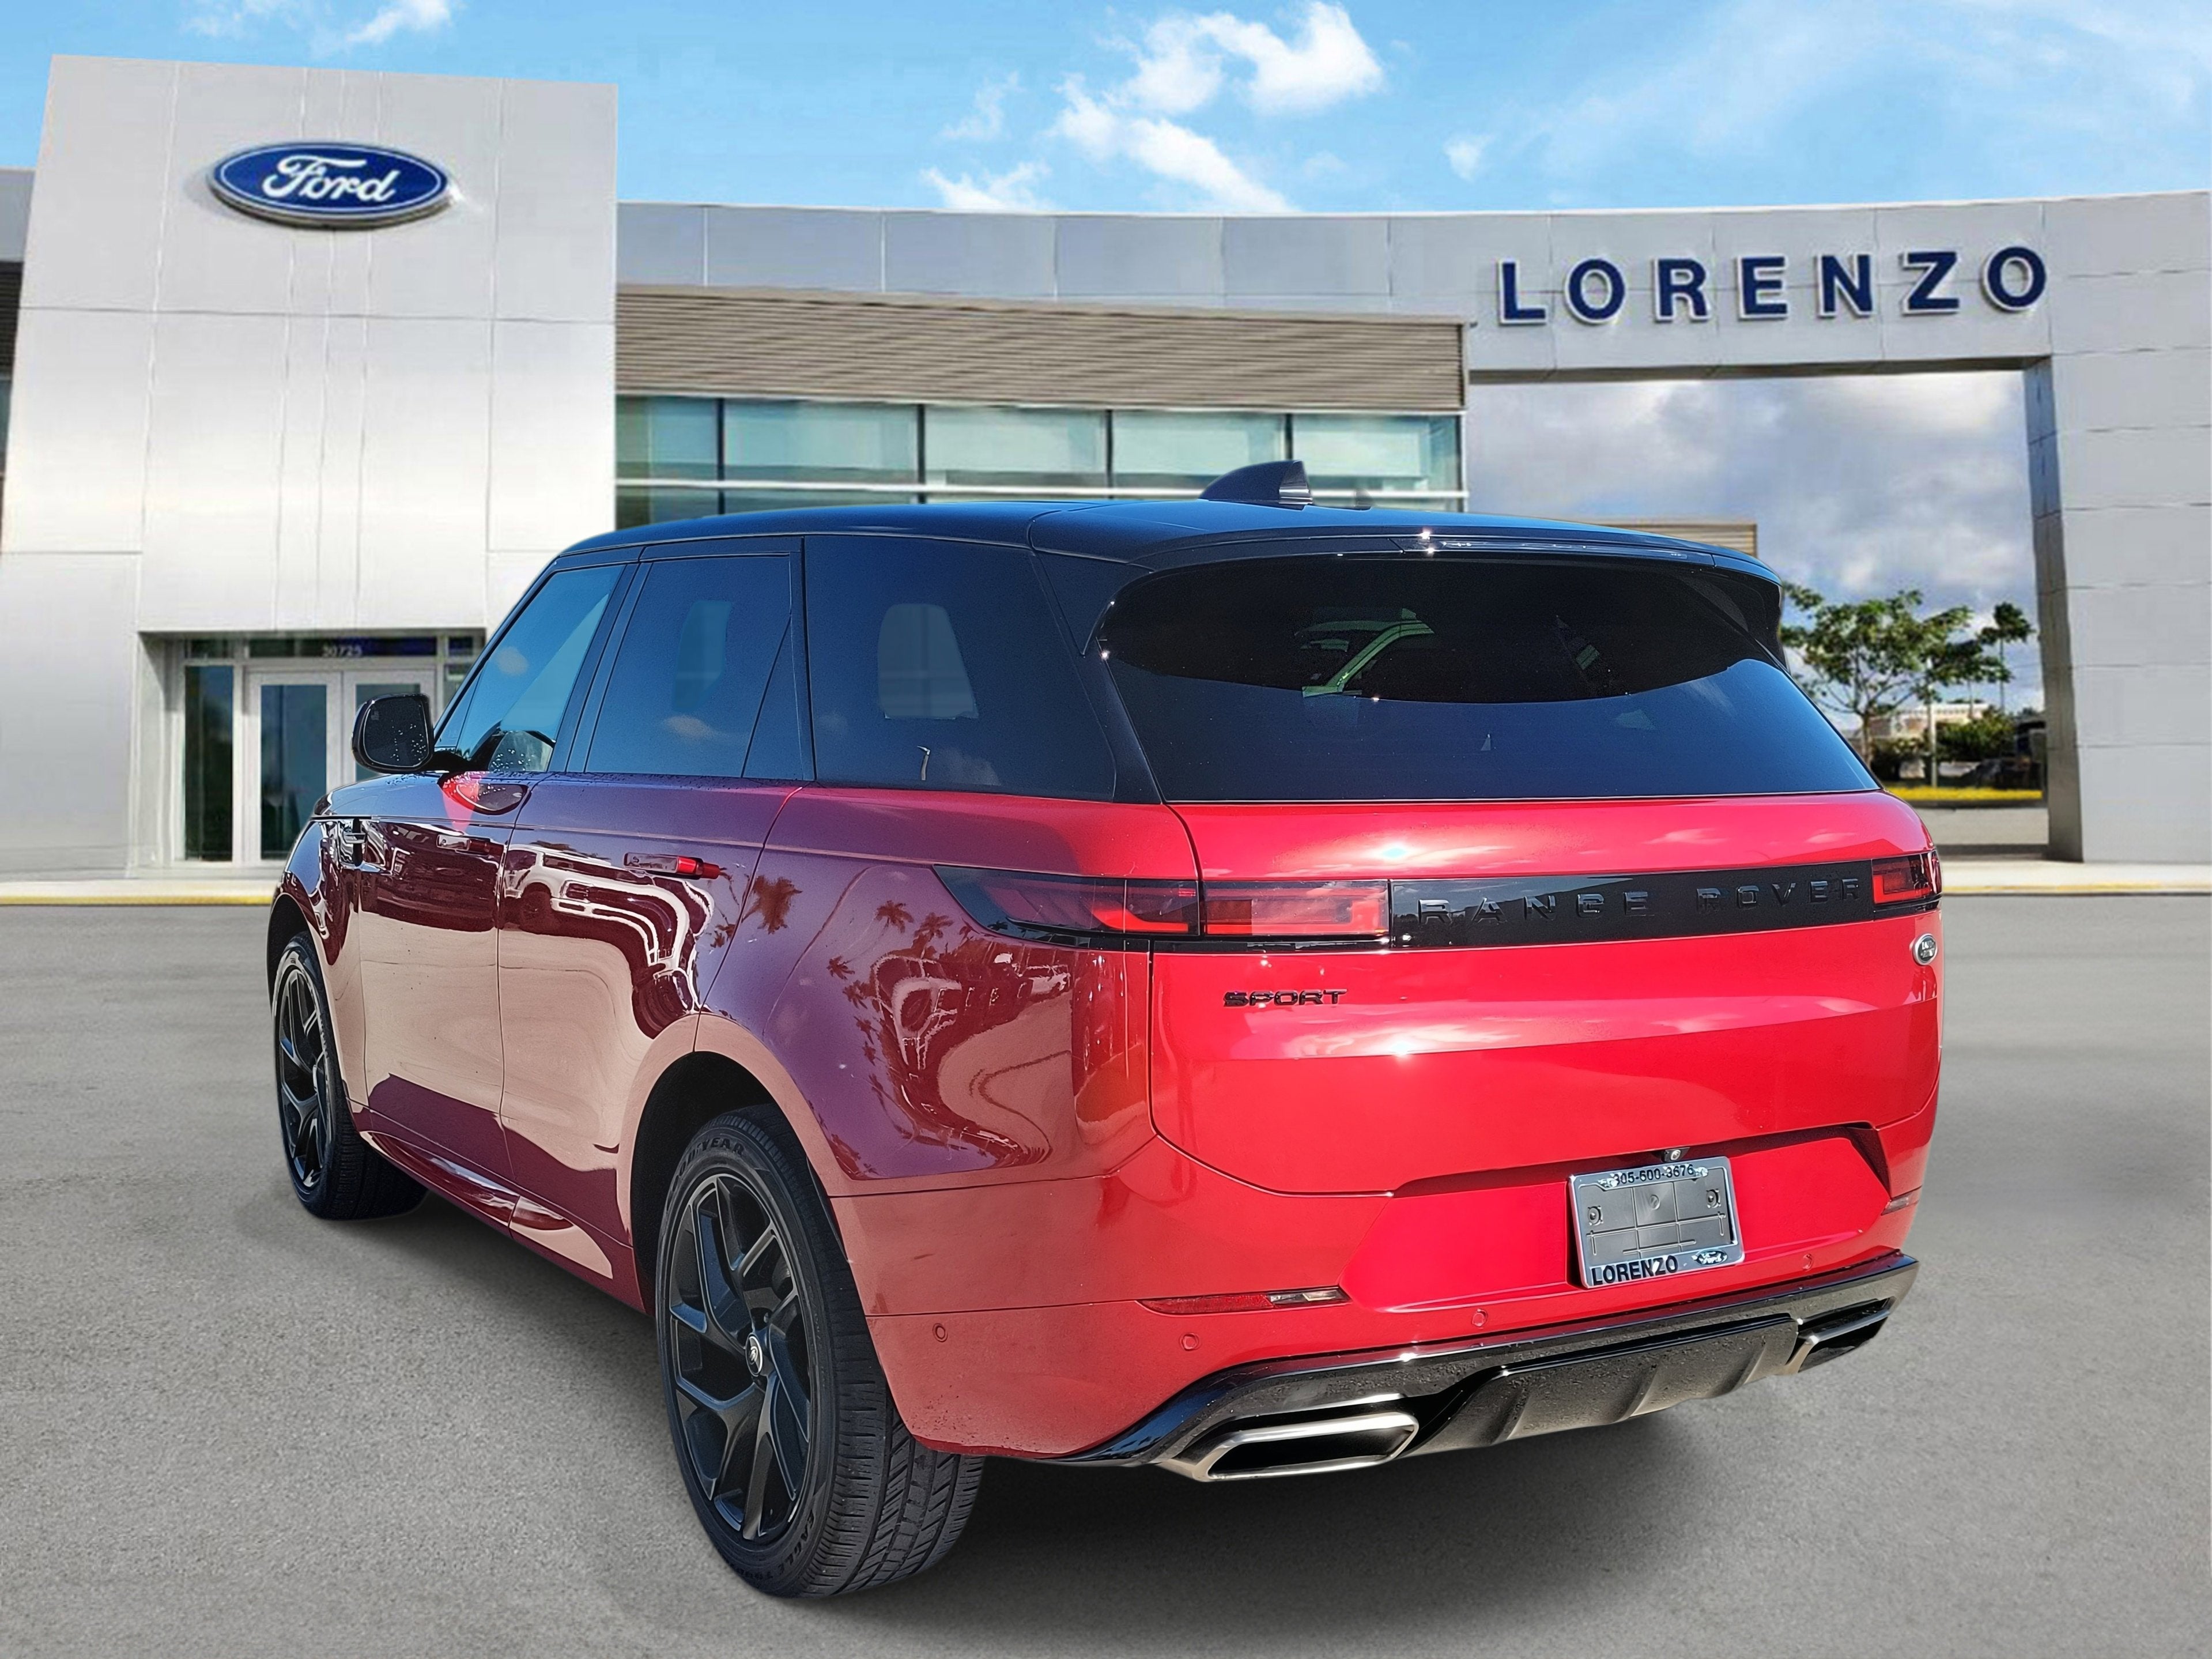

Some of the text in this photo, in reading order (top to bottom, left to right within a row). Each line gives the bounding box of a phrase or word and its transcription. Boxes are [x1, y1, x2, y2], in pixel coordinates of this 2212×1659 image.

[262, 154, 401, 202] Ford
[1500, 246, 2047, 324] LORENZO
[1417, 878, 1859, 923] RANGE ROVER
[1223, 988, 1347, 1008] SPORT
[1613, 1163, 1695, 1186] 305-600-3676
[1591, 1255, 1678, 1286] LORENZO
